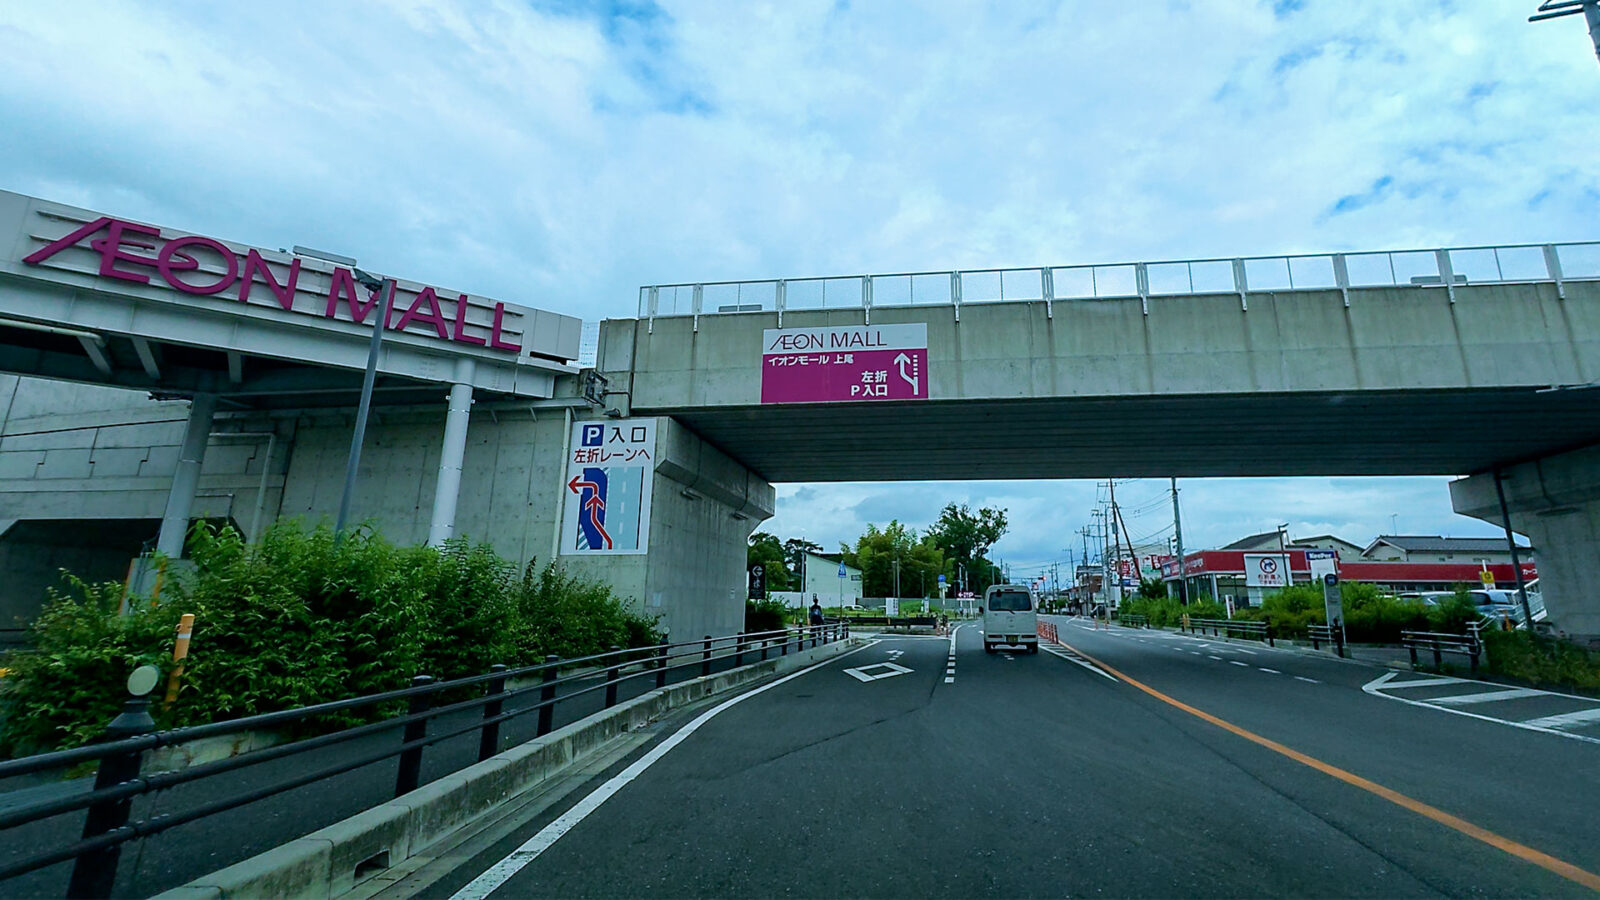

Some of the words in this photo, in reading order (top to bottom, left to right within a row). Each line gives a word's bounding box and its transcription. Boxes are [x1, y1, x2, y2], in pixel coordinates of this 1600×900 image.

[325, 266, 523, 353] MALL
[830, 330, 888, 348] MALL
[768, 355, 830, 366] イオンモール
[833, 354, 854, 365] 上尾
[861, 370, 888, 383] 左折
[585, 426, 602, 445] P
[608, 426, 647, 444] 入口
[573, 448, 651, 464] 左折レーンへ
